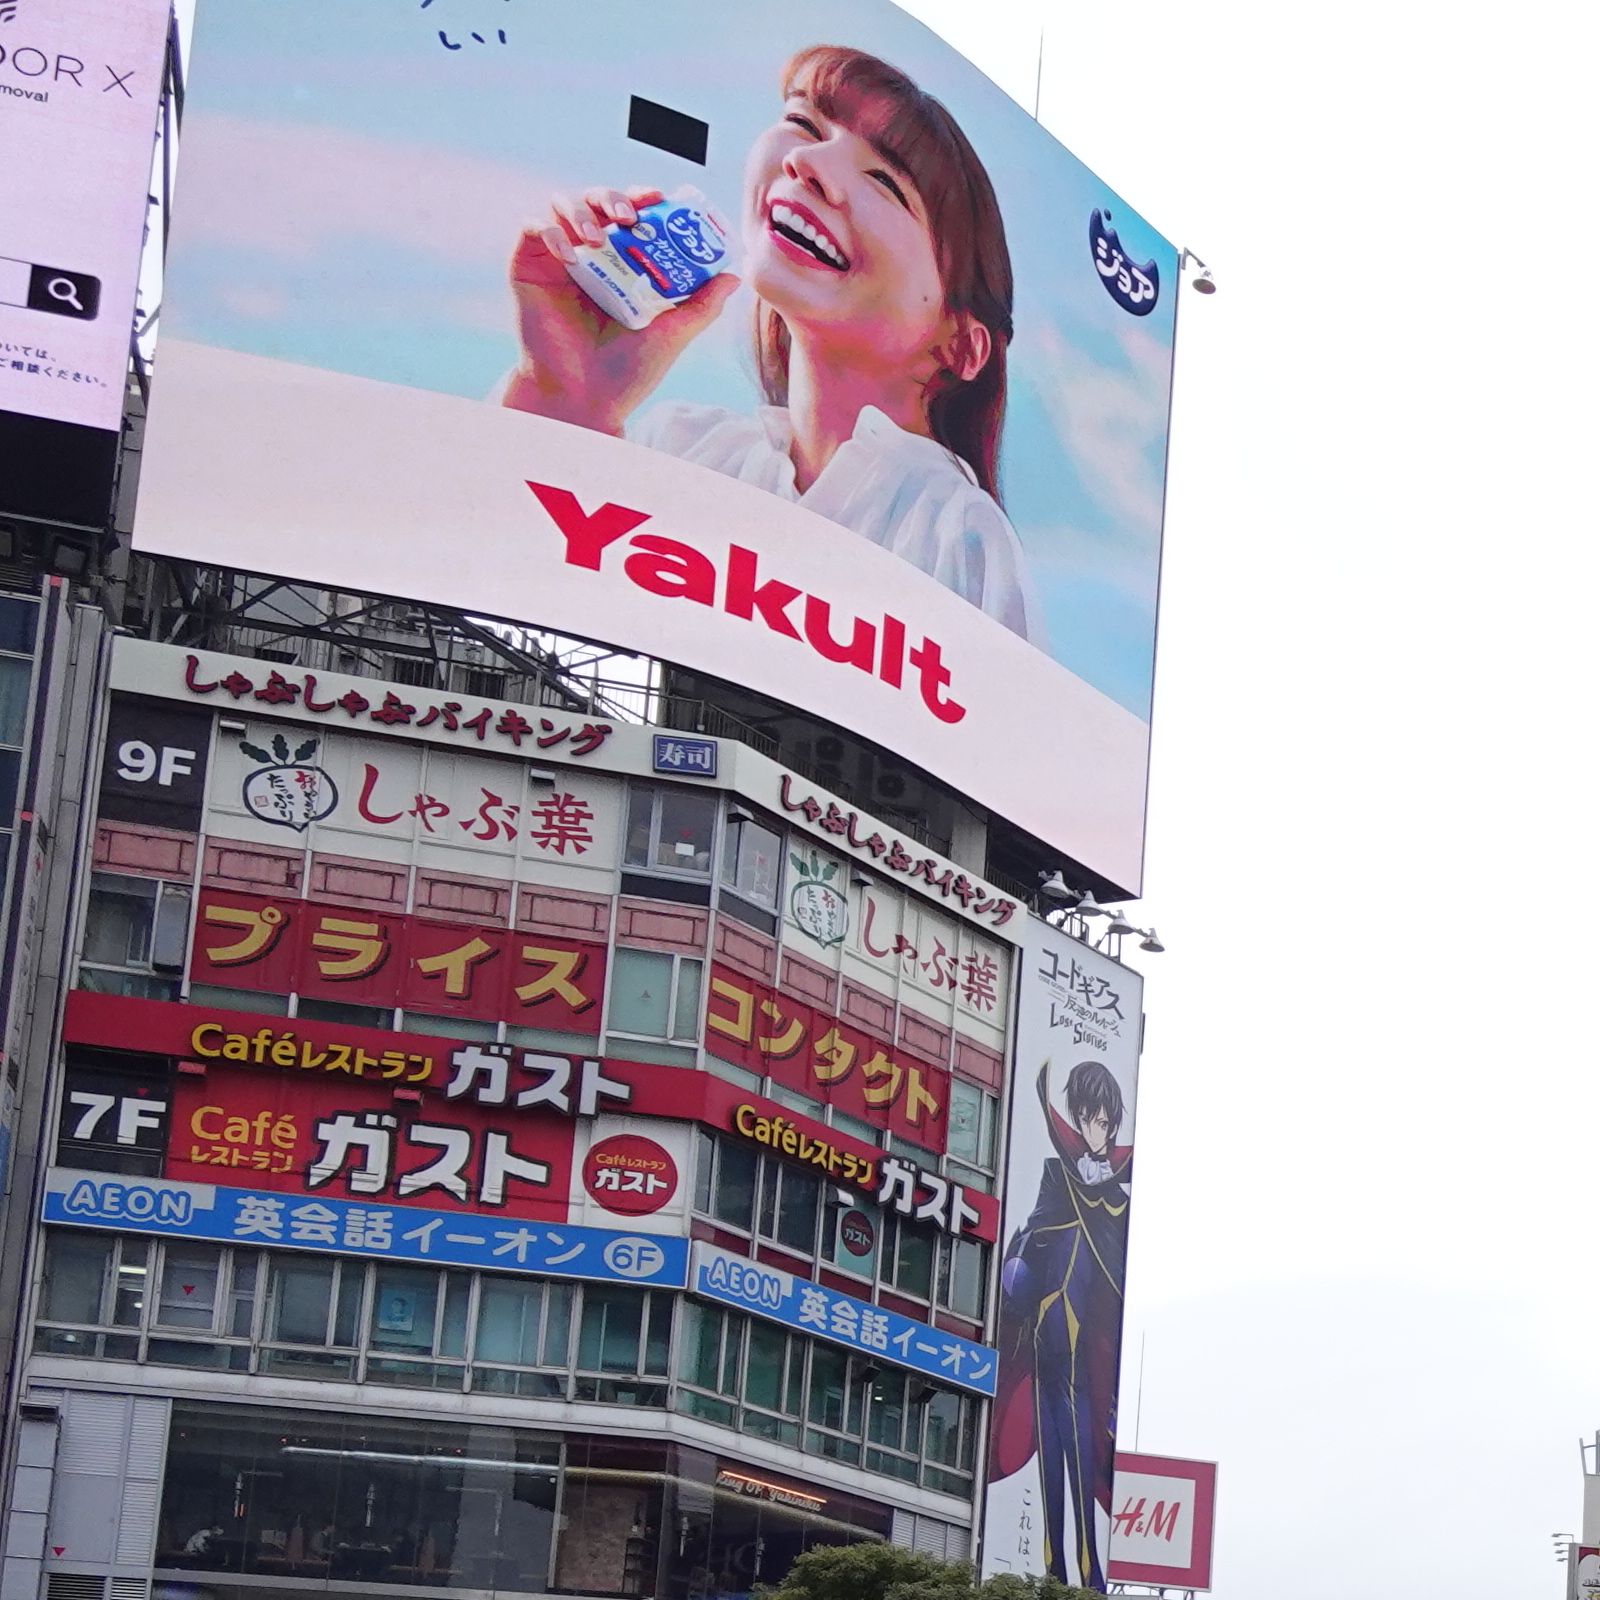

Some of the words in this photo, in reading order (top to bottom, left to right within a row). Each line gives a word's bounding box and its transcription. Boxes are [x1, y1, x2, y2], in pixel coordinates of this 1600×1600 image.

[1094, 242, 1160, 308] ジョア
[524, 477, 970, 727] Yakult
[183, 652, 613, 757] しゃぶしゃぶバイキング
[117, 738, 197, 789] 9F
[657, 742, 714, 771] 寿司
[357, 762, 596, 857] しゃぶ葉
[780, 773, 1018, 927] しゃぶしゃぶバイキング
[203, 905, 596, 1013] プライス
[863, 895, 999, 1013] しゃぶ葉
[1039, 948, 1125, 1020] コードギアス
[446, 1043, 632, 1117] ガスト
[707, 977, 941, 1124] コンタクト
[69, 1091, 167, 1145] 7F
[190, 1105, 298, 1149] Café
[190, 1146, 294, 1174] レストラン
[307, 1112, 549, 1208] ガスト
[594, 1168, 669, 1195] ガスト
[67, 1183, 192, 1224] AEON
[878, 1158, 980, 1236] ガスト
[609, 1243, 661, 1272] 6F
[844, 1227, 872, 1247] ガスト
[707, 1256, 783, 1308] AEON
[1113, 1495, 1180, 1542] H&M
